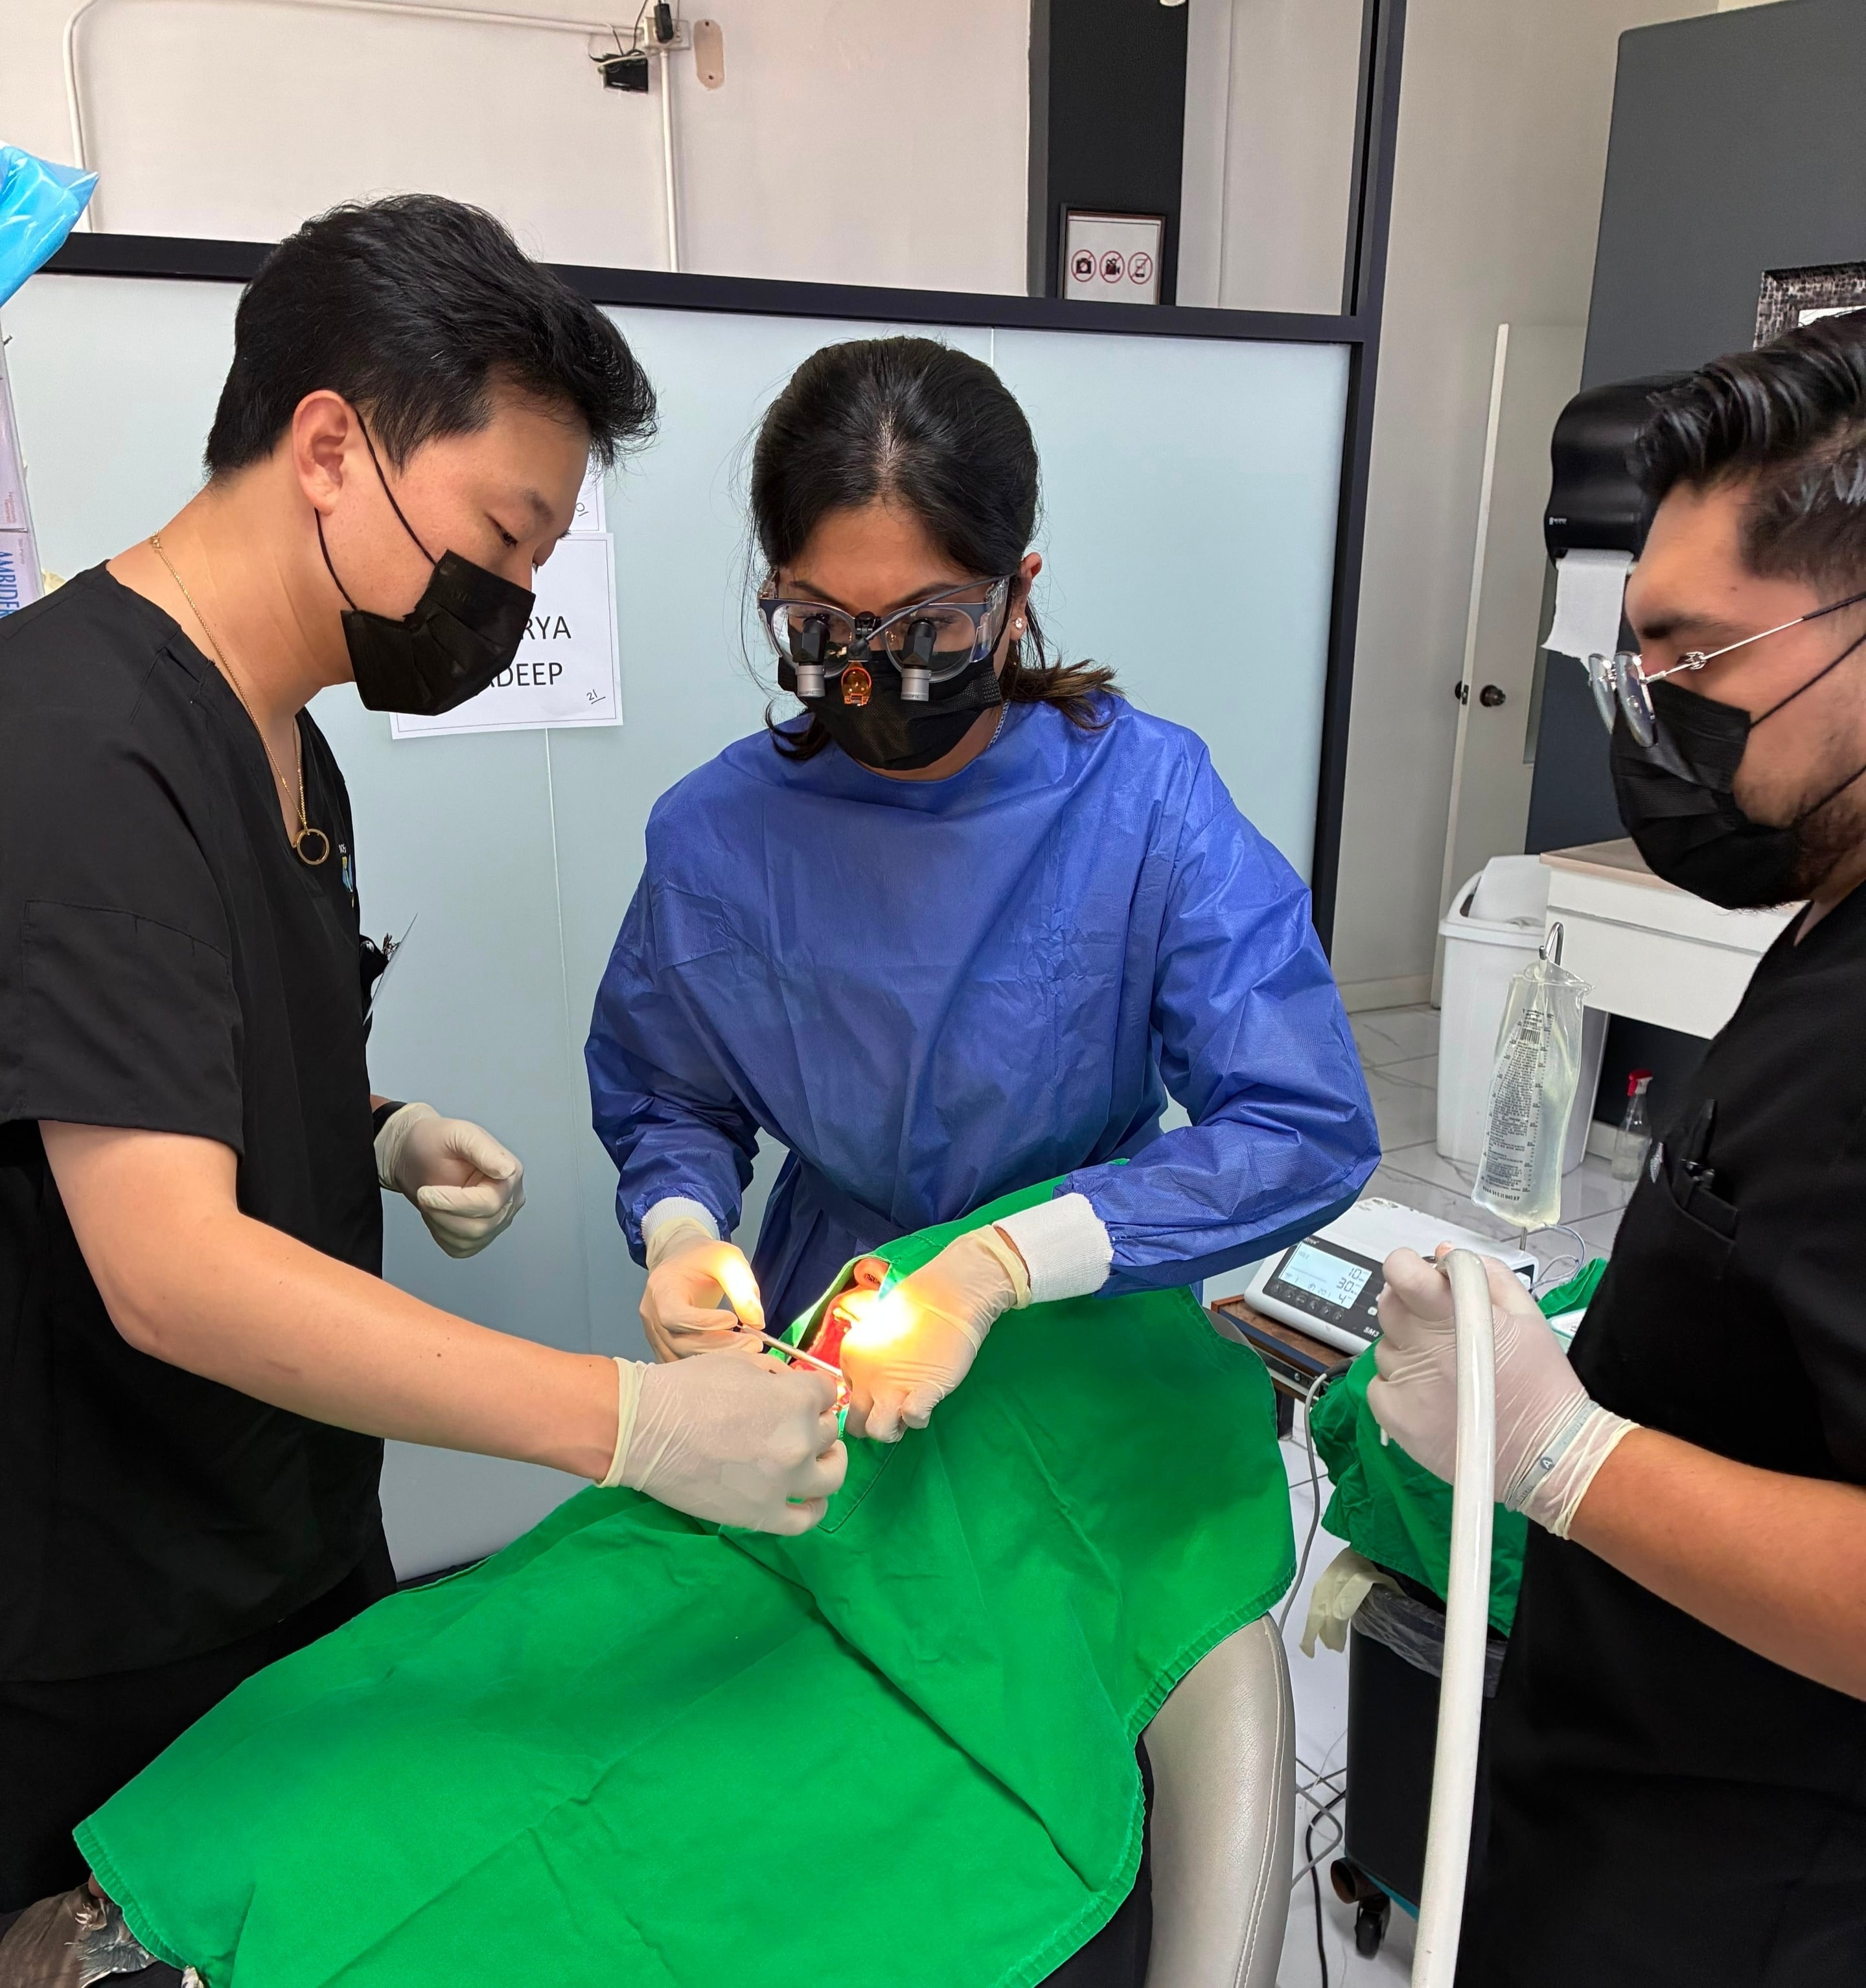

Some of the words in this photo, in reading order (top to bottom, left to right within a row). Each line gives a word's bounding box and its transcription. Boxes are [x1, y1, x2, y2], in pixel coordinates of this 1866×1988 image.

[490, 662, 563, 687] DEEP
[586, 689, 600, 702] 21
[1348, 1267, 1363, 1281] 10
[1337, 1277, 1354, 1292] 30
[1339, 1294, 1347, 1304] 4
[1363, 1326, 1380, 1338] SM3
